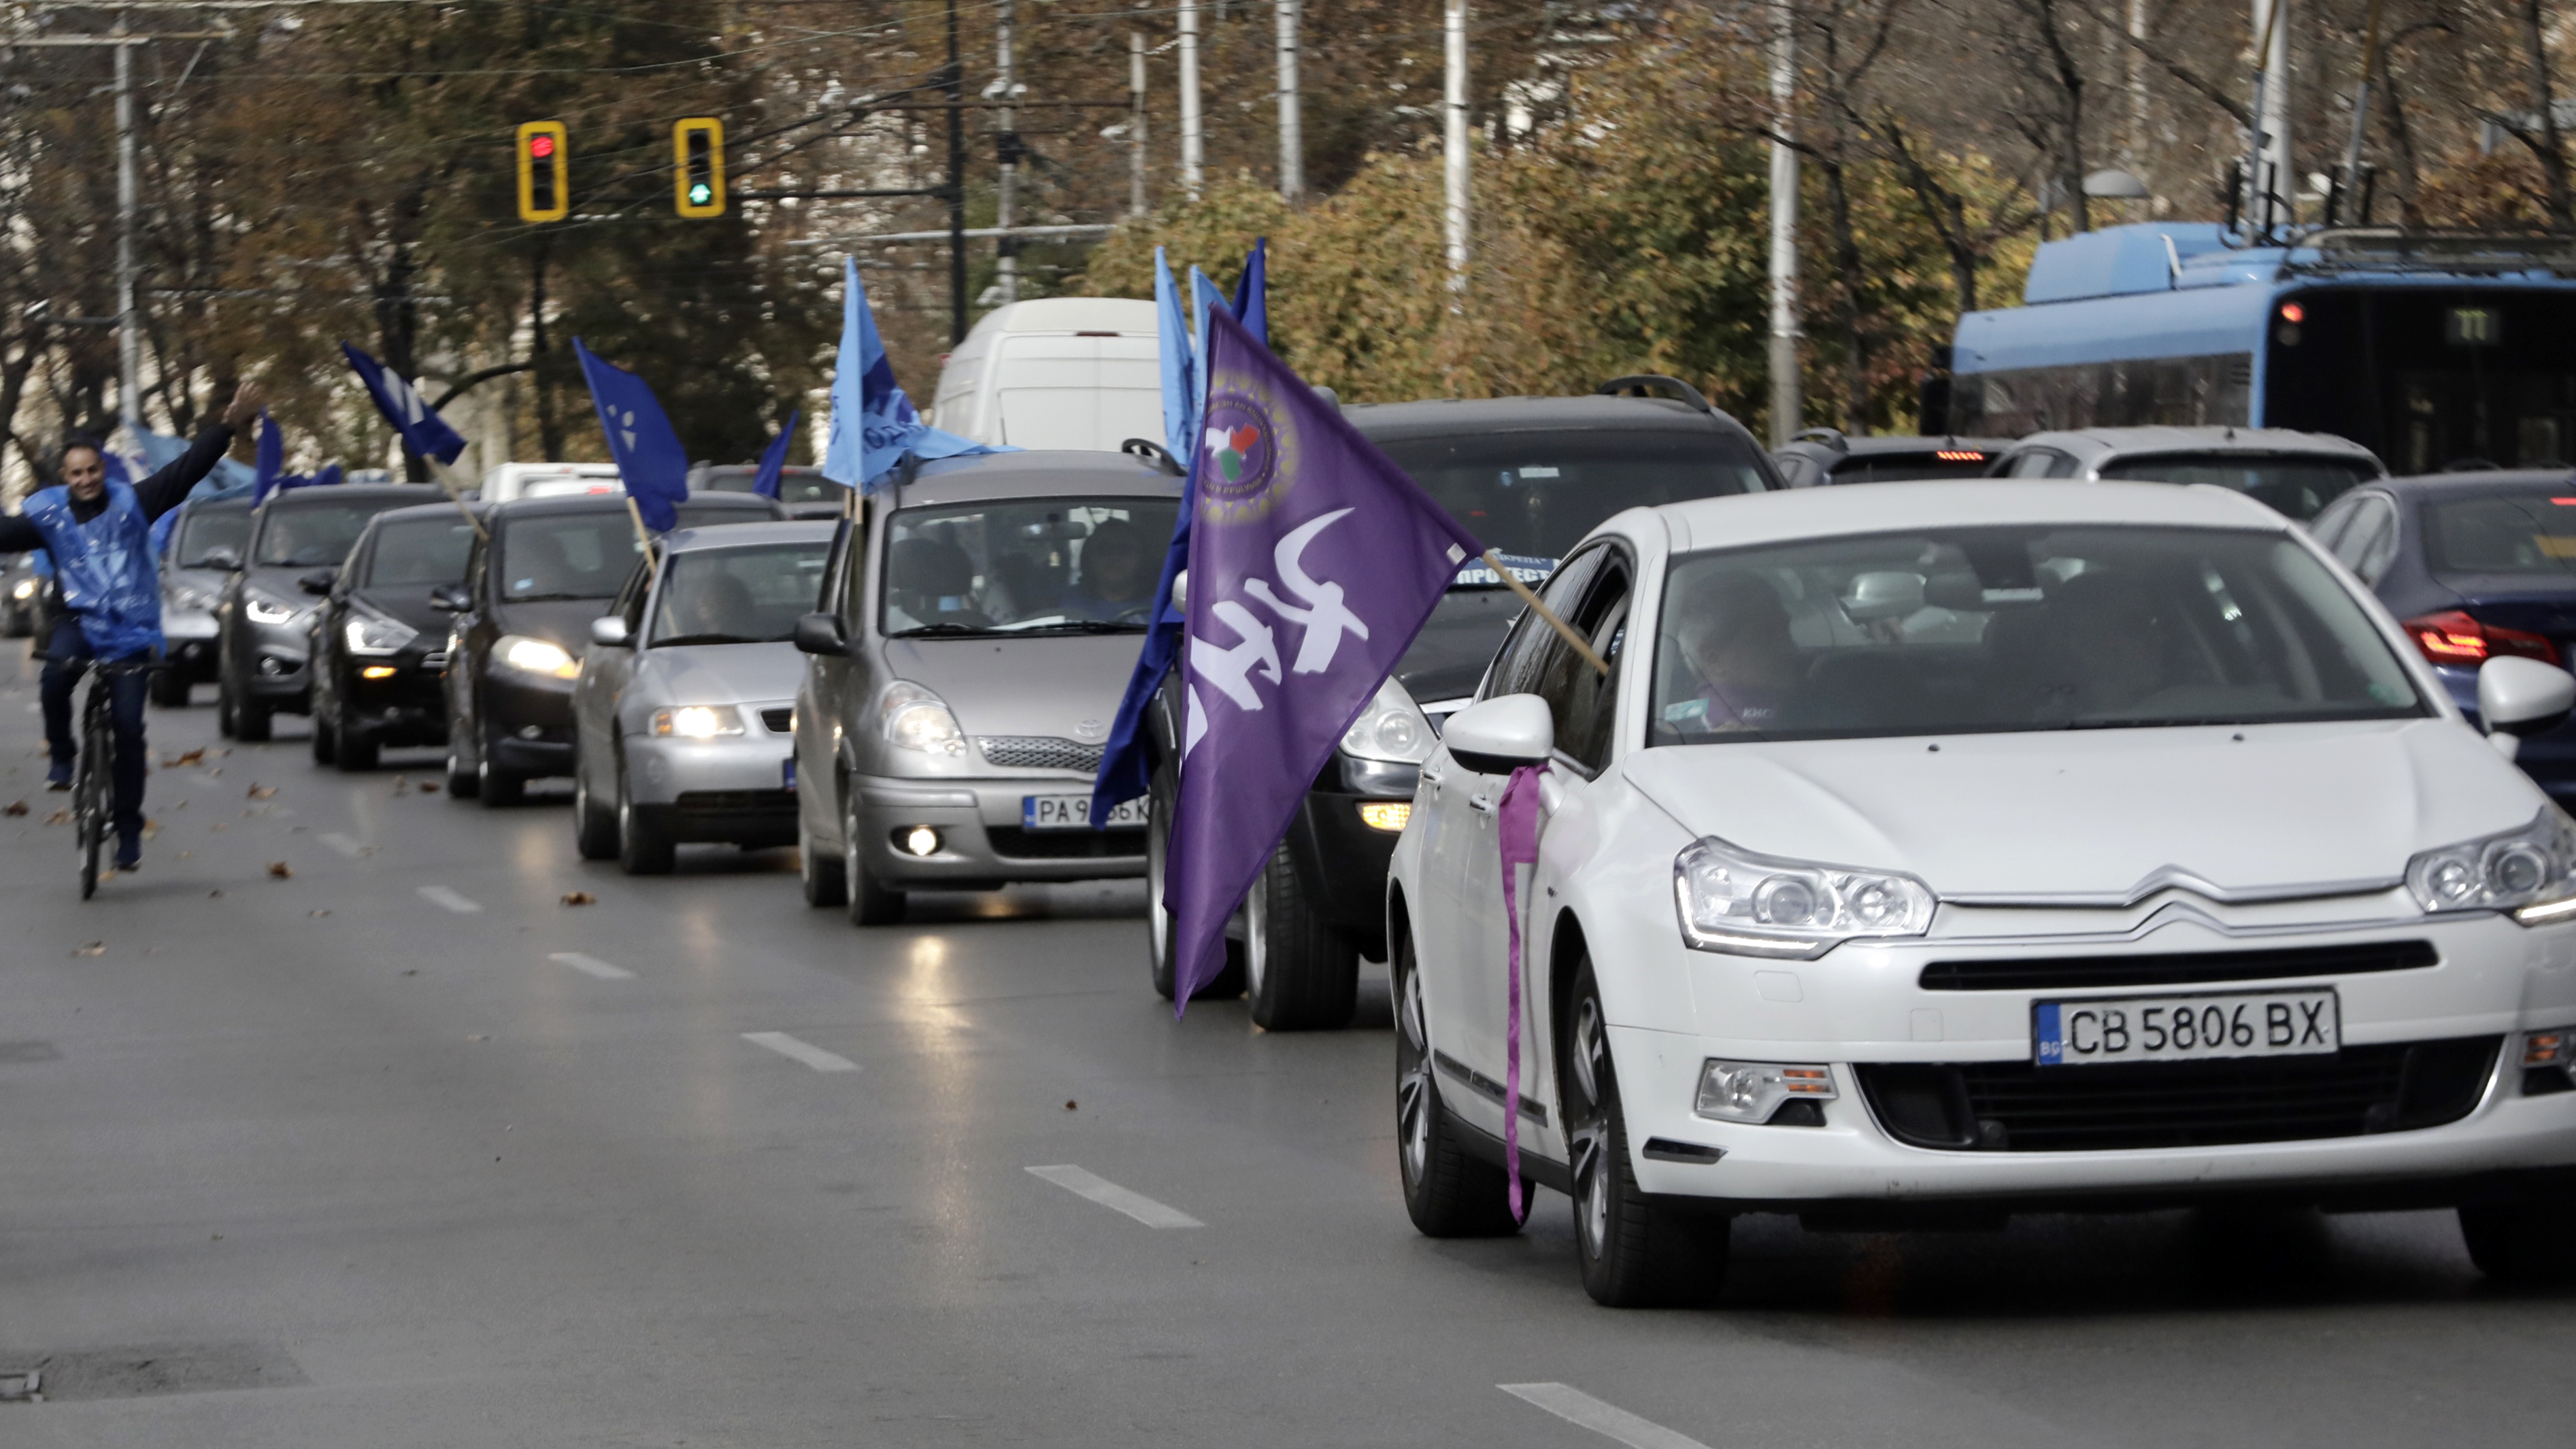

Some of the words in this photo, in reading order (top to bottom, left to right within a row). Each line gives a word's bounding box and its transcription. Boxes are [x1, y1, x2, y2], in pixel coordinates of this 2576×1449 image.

[2041, 1041, 2060, 1056] BG
[2071, 1010, 2130, 1054] CB
[2143, 1003, 2254, 1051] 5806
[2266, 999, 2325, 1048] BX
